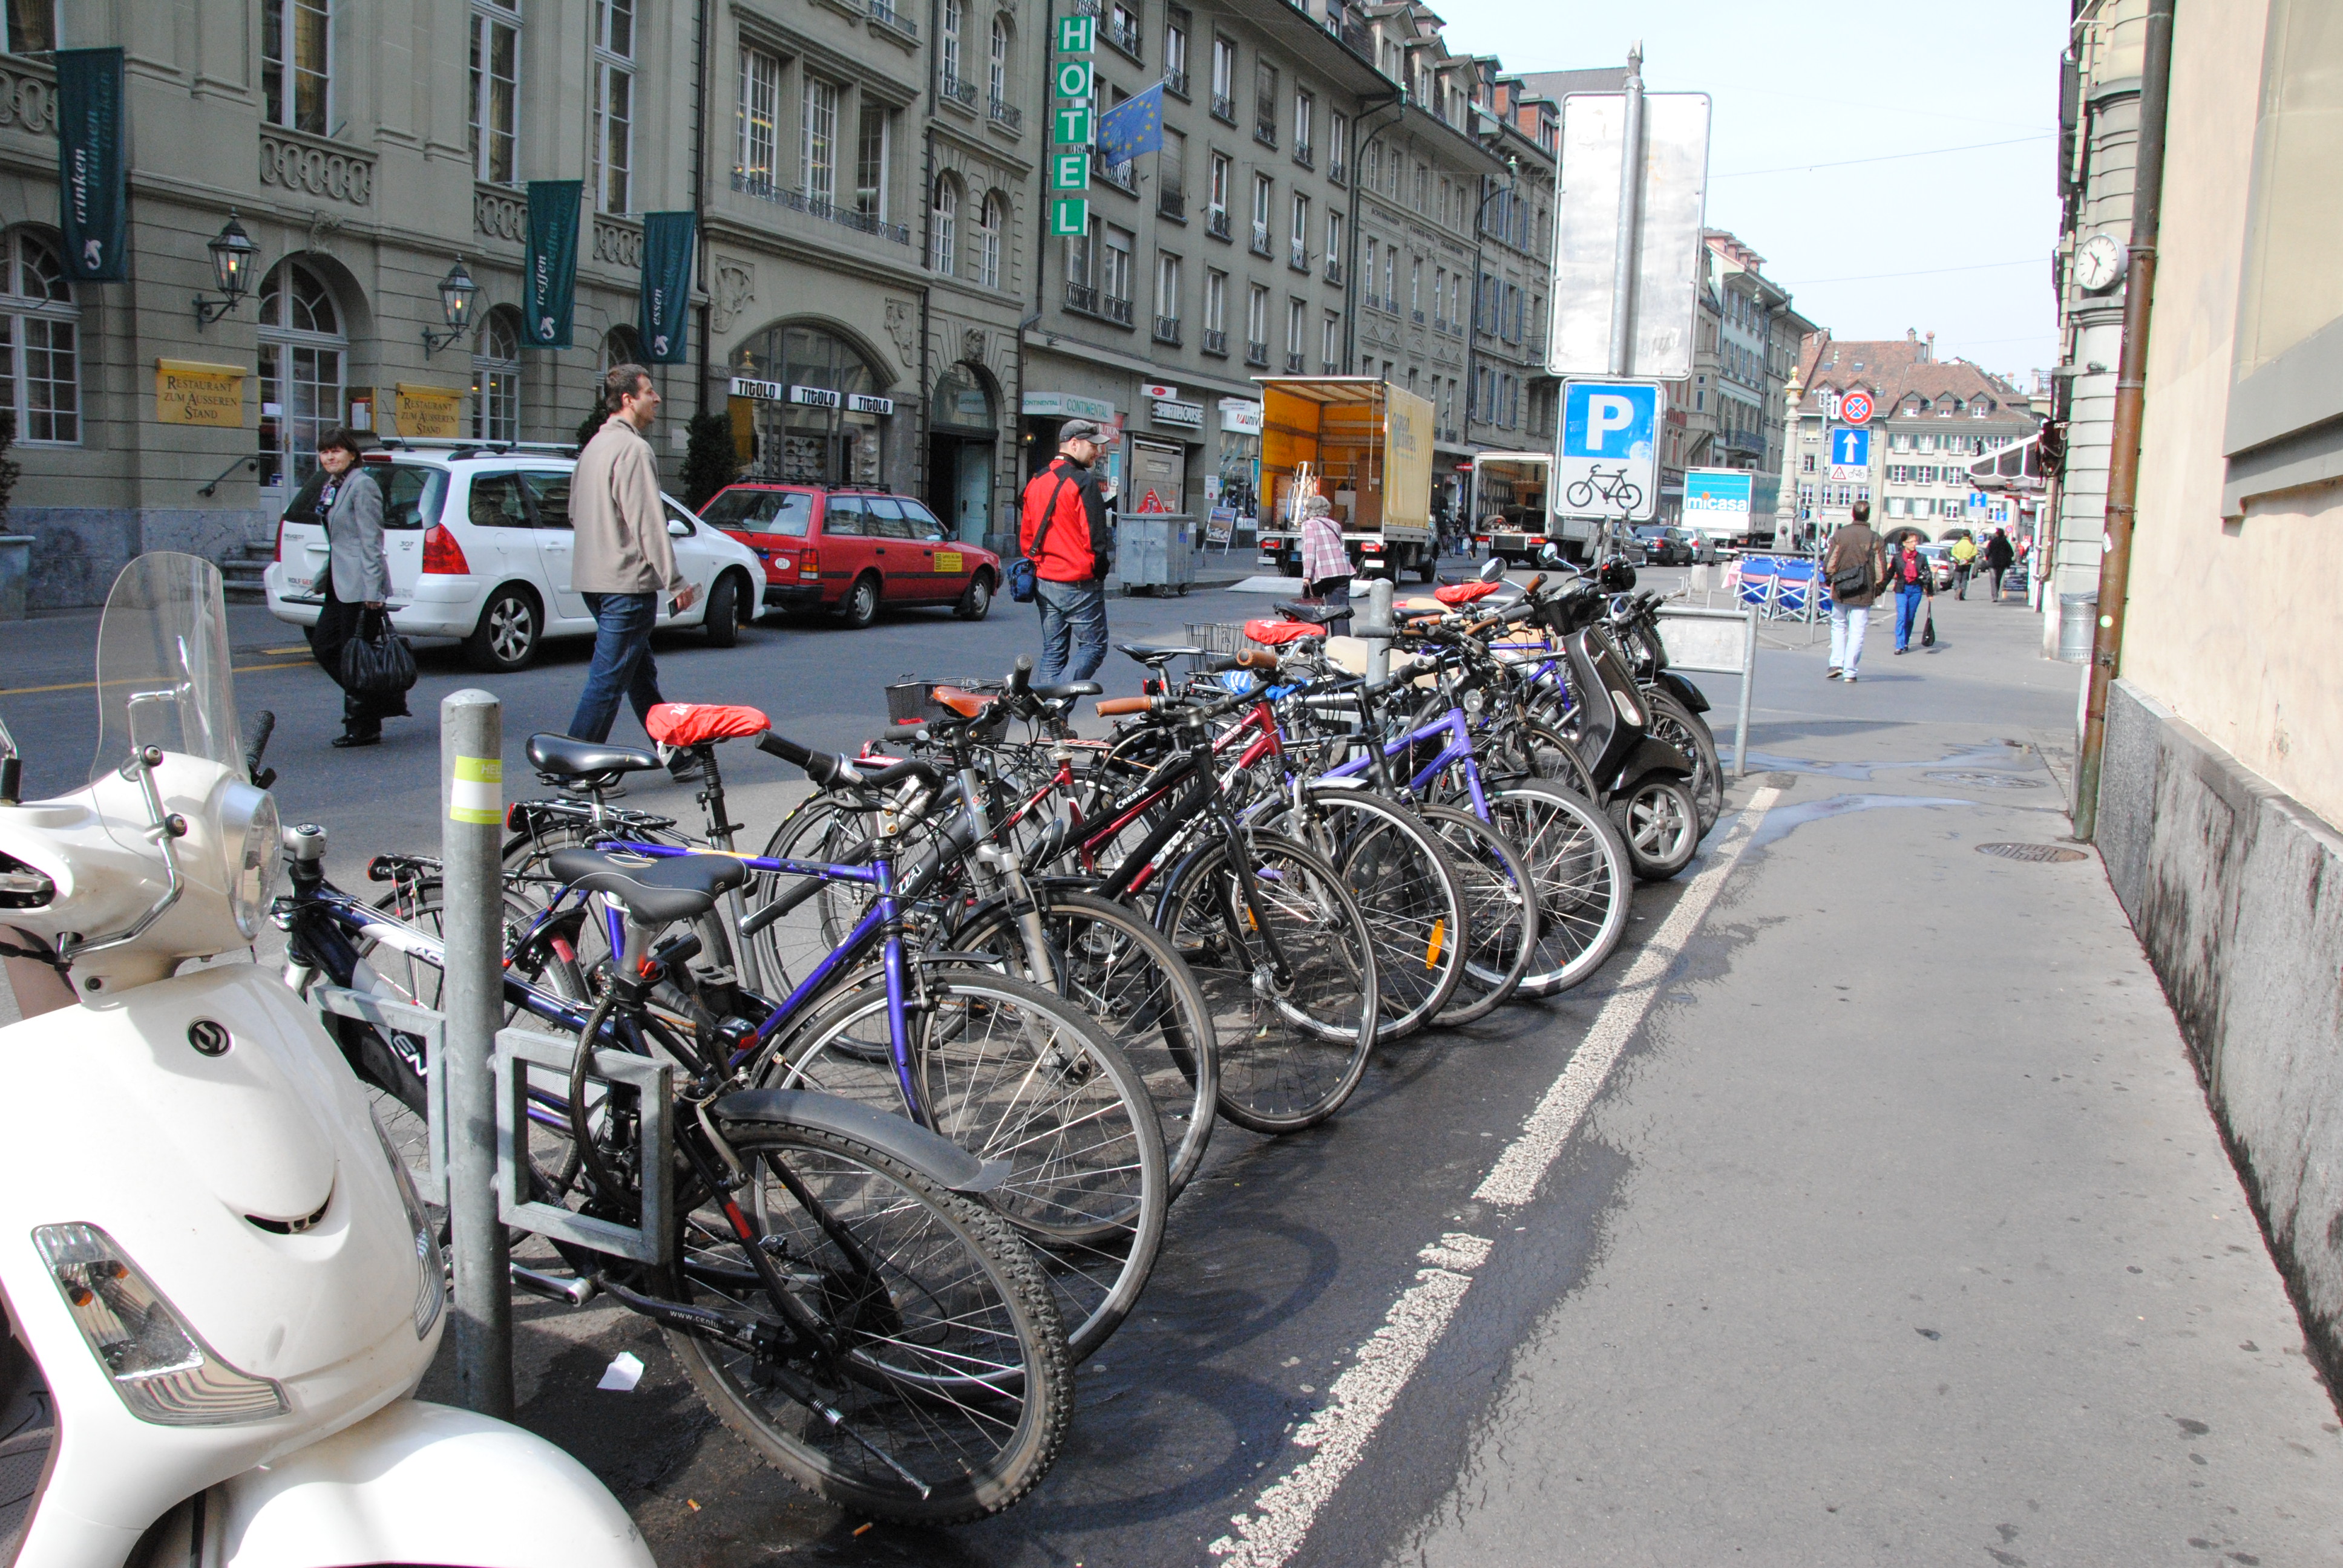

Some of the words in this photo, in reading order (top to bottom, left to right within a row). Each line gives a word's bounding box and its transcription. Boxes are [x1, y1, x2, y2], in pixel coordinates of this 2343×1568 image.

[1060, 19, 1086, 231] HOTEL
[71, 148, 87, 224] trinken
[536, 255, 549, 305] treffen
[653, 289, 663, 326] essen
[167, 376, 232, 392] RESTAURANT
[164, 392, 185, 402] ZUM
[404, 397, 452, 411] RESTAURANT
[185, 406, 218, 420] STAND
[1067, 398, 1108, 418] CONTINENTAL
[1156, 402, 1203, 423] SHIRTHOUSE
[417, 423, 441, 435] STAND
[1586, 394, 1634, 450] P
[1687, 492, 1747, 511] micasa
[778, 559, 787, 568] CH
[1115, 786, 1149, 810] CRESTA
[670, 1310, 722, 1330] www.centu
